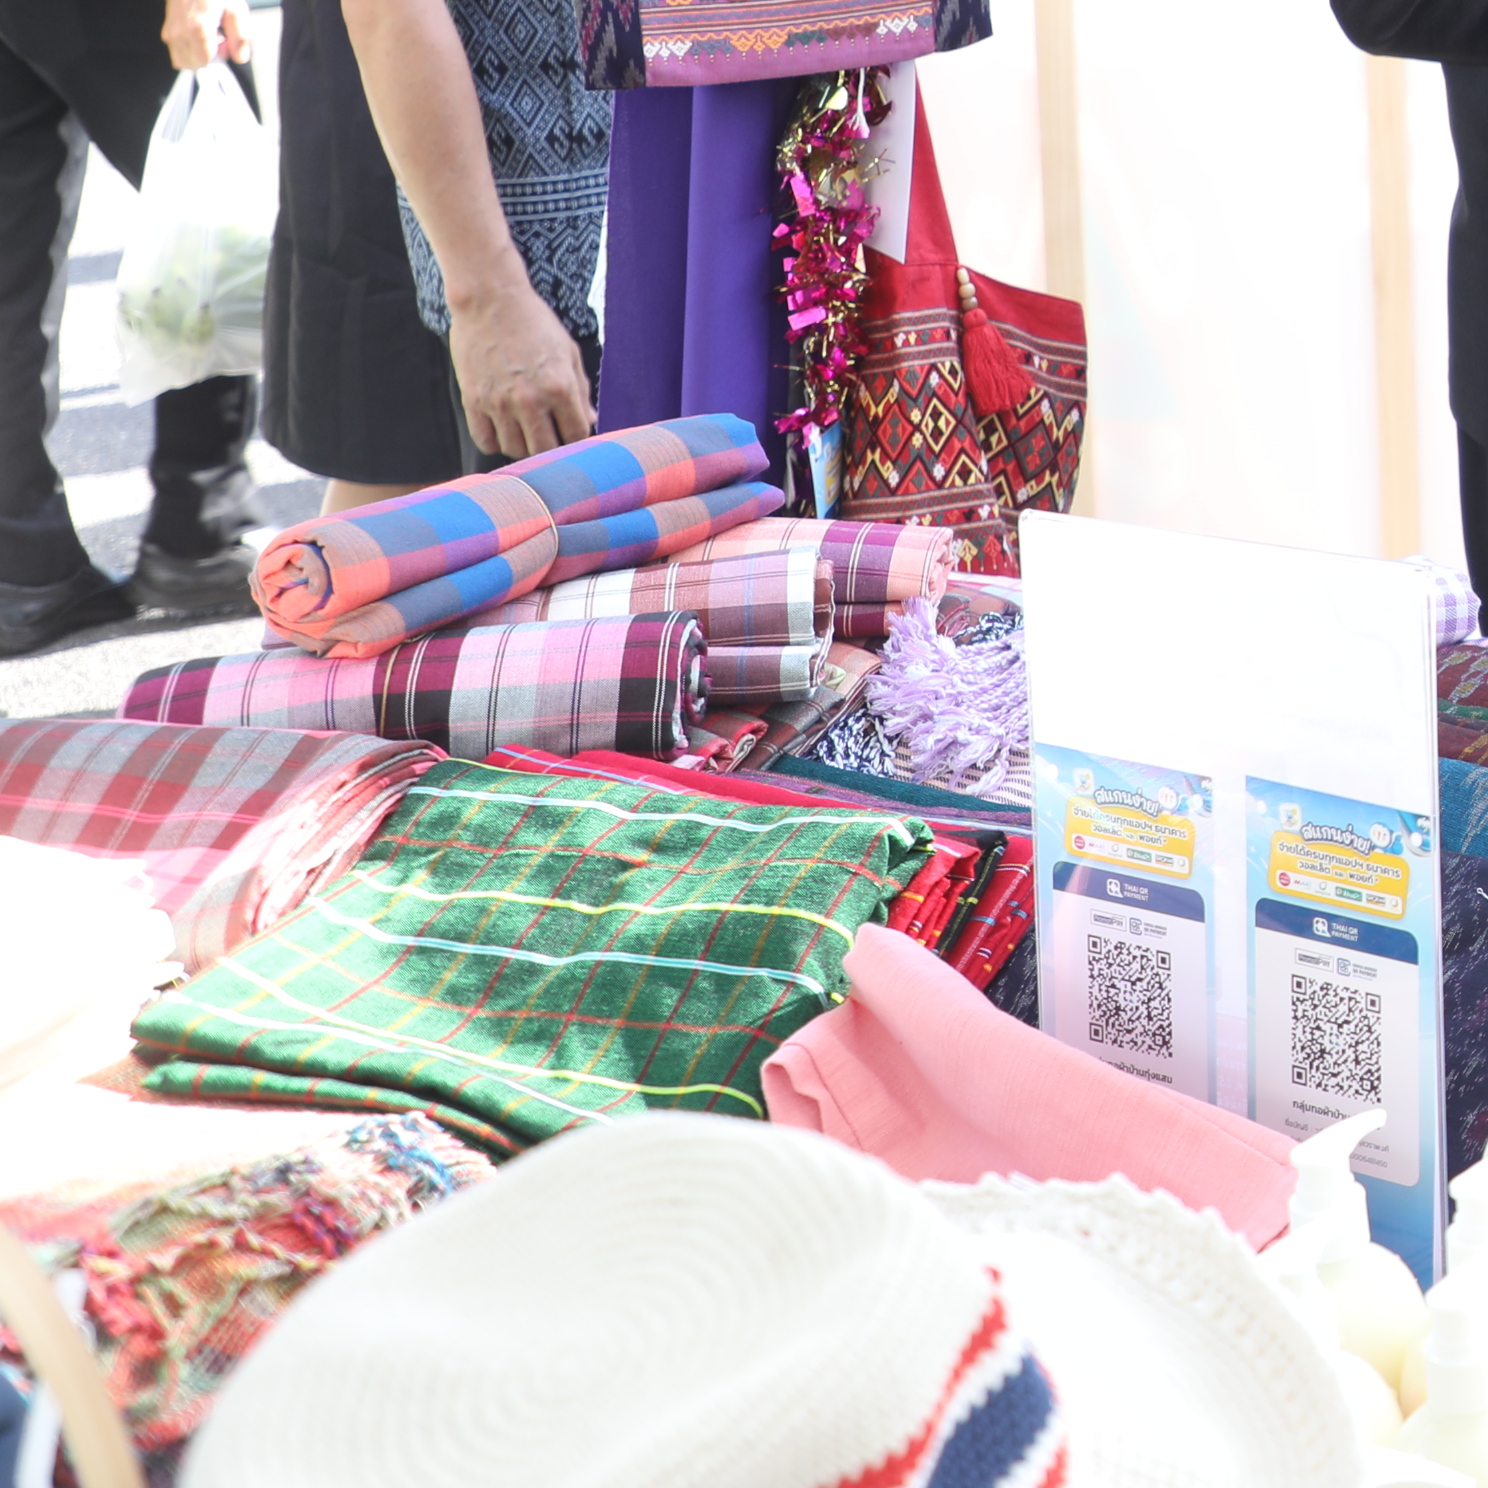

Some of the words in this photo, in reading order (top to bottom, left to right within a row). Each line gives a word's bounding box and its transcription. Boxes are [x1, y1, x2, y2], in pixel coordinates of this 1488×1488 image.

[1095, 786, 1160, 817] สแกนง่าย!
[1154, 825, 1188, 839] ธนาคาร
[1301, 821, 1371, 855] สแกนง่าย!
[1366, 863, 1401, 878] ธนาคาร
[1124, 883, 1138, 893] THAI
[1139, 886, 1149, 895] QR
[1124, 891, 1149, 901] PAYMENT
[1332, 923, 1348, 932] THAI
[1348, 926, 1359, 935] QR
[1331, 931, 1359, 942] PAYMENT
